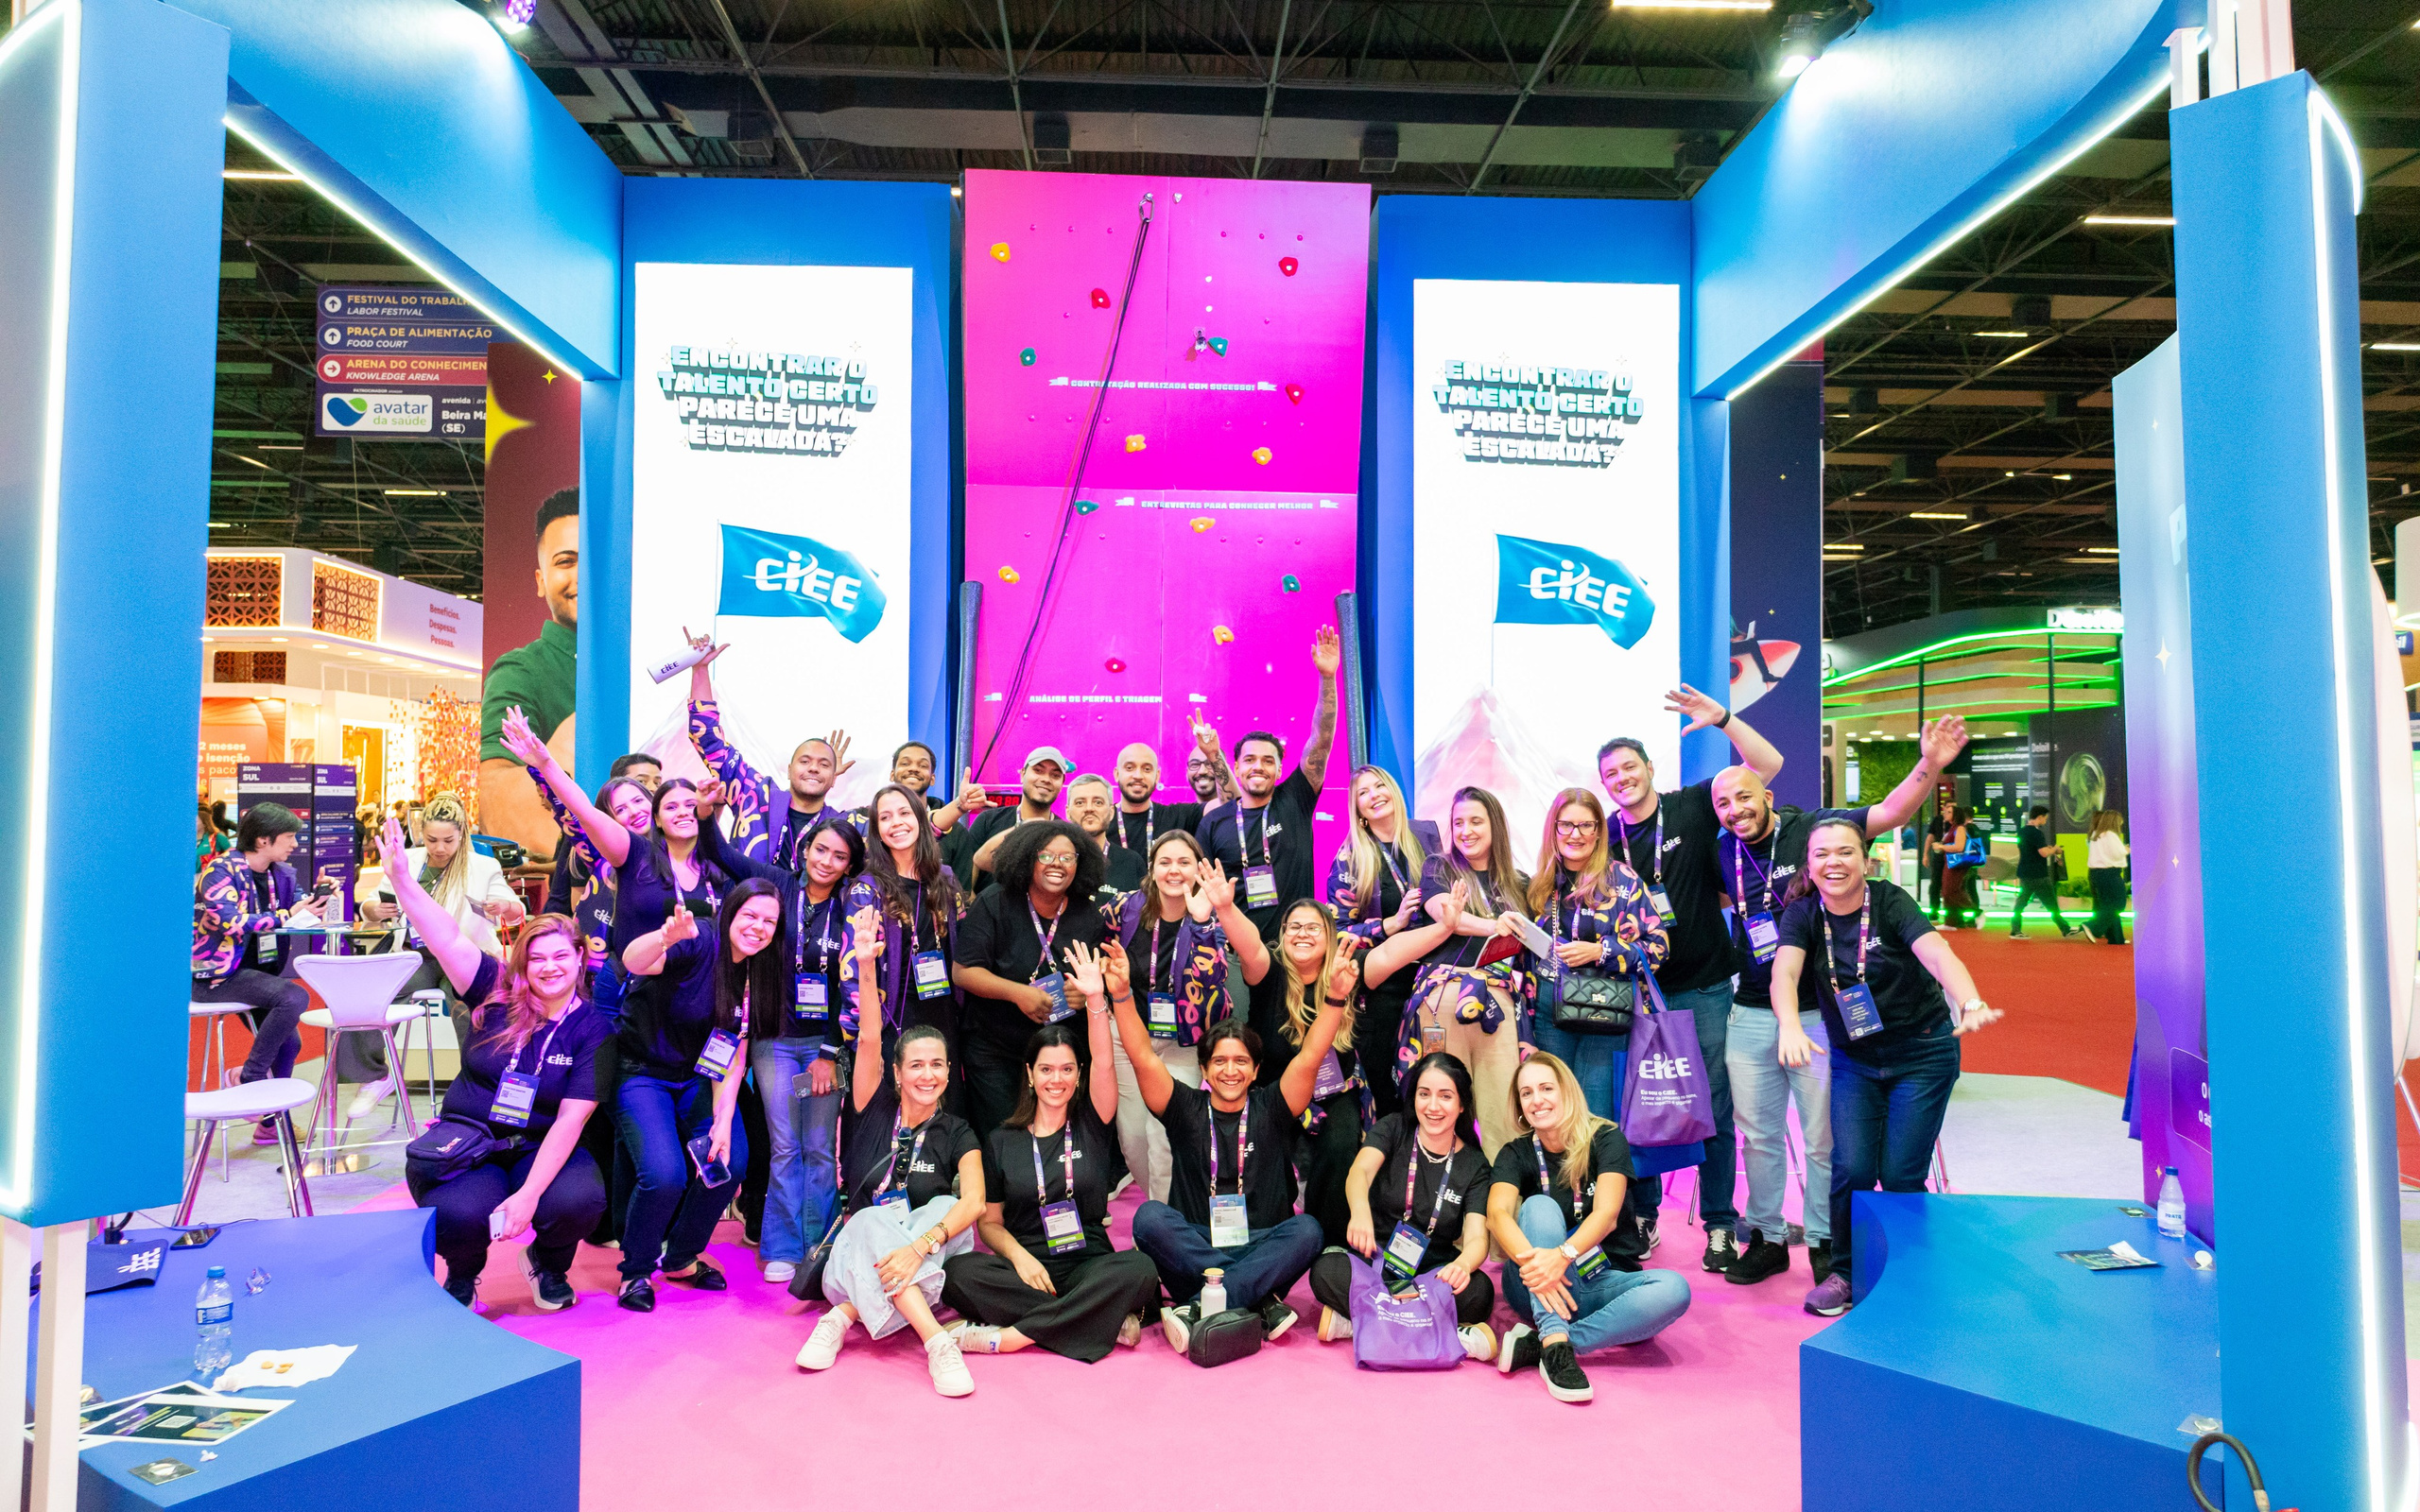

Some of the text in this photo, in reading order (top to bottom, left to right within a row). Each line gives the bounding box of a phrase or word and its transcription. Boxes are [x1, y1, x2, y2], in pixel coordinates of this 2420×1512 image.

[347, 295, 398, 304] FESTIVAL
[401, 296, 417, 305] DO
[346, 307, 424, 317] LABOR FESTIVAL
[347, 327, 493, 338] PRAÇA DE ALIMENTAÇÃO
[375, 340, 408, 349] COURT
[346, 359, 387, 369] ARENA
[389, 360, 407, 369] DO
[670, 345, 867, 381] ENCONTRAR O
[346, 372, 440, 382] KNOWLEDGE ARENA
[1444, 359, 1633, 393] ENCONTRAR O
[657, 370, 878, 408] TALENTO CERTO
[1137, 381, 1187, 389] REALIZADA
[1188, 382, 1208, 390] COM
[1432, 384, 1644, 420] TALENTO CERTO
[373, 402, 428, 415] avatar
[678, 396, 857, 430] PARECE UMA
[373, 415, 426, 426] da saúde
[441, 410, 471, 421] Beira
[441, 423, 465, 434] (SE)
[1453, 409, 1625, 441] PARECE UMA
[687, 423, 849, 455] ESCALADA?
[1463, 436, 1616, 466] ESCALADA?
[1141, 501, 1202, 509] ENTREVISTAS
[1029, 695, 1067, 703] ANÁLISE
[209, 742, 247, 750] meses
[206, 753, 251, 763] isenção
[242, 773, 260, 782] SUL
